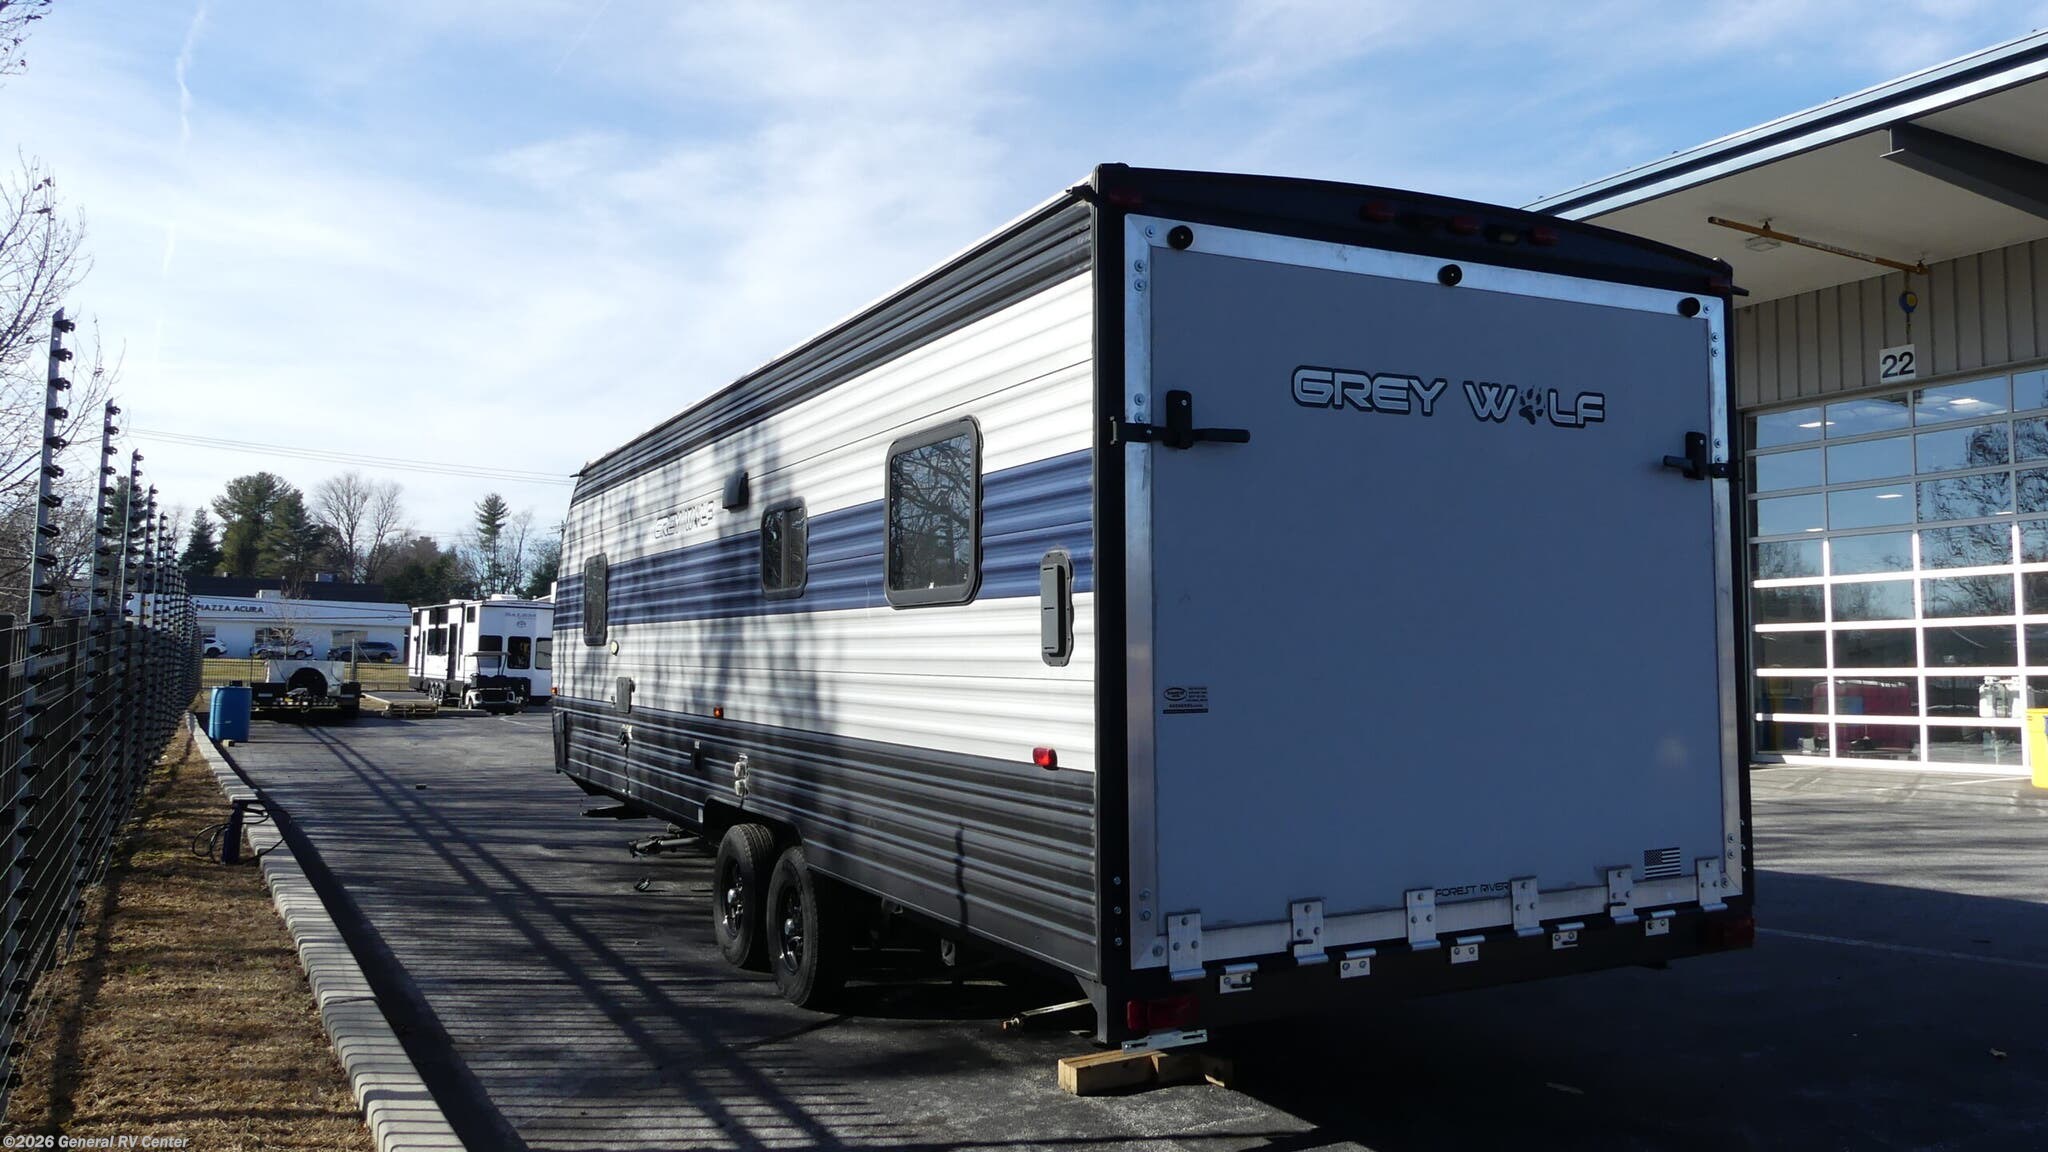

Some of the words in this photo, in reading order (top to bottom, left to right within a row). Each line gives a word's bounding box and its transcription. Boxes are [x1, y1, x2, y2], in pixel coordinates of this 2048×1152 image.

[1881, 351, 1915, 379] 22
[1291, 365, 1448, 417] GREY
[1463, 380, 1605, 429] WLF
[233, 605, 265, 613] ACURA
[1435, 885, 1477, 897] FOREST
